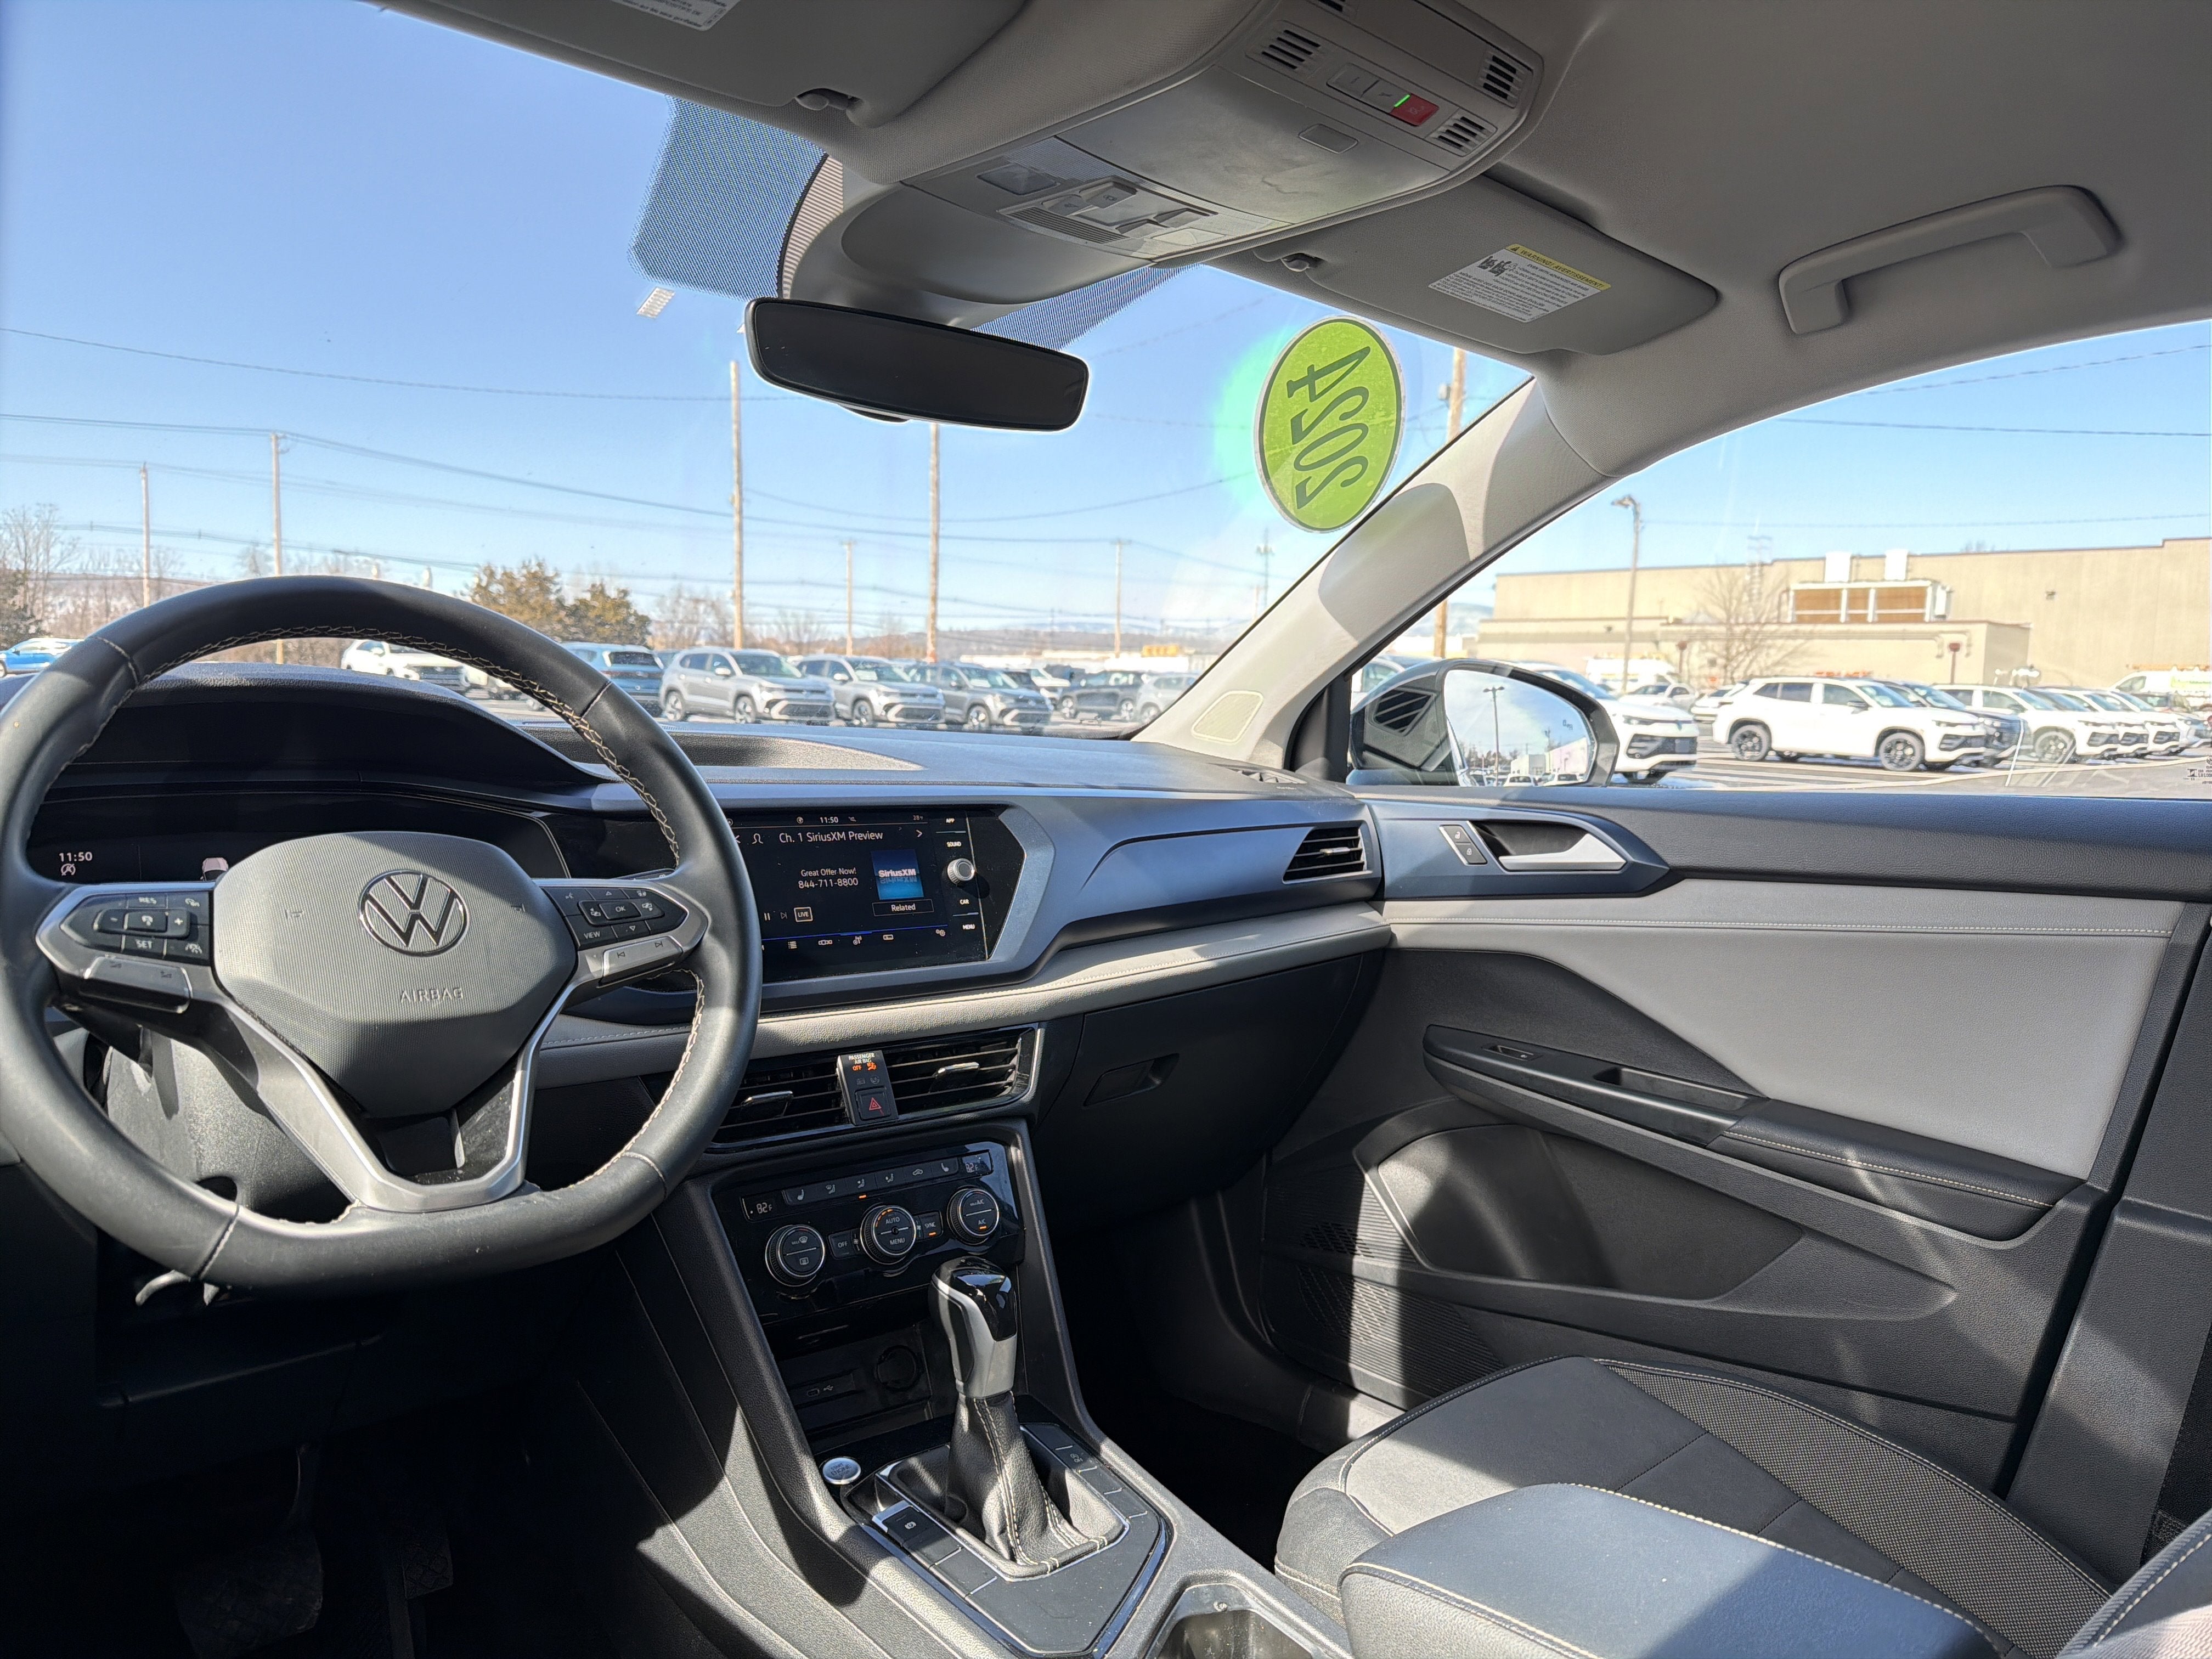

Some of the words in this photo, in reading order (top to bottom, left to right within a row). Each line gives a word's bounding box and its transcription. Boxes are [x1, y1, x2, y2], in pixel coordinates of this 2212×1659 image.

[1520, 250, 1555, 267] WARNING!
[1553, 264, 1606, 288] AVERTISSEMENT!
[779, 833, 795, 843] Ch.
[798, 832, 803, 842] 1
[806, 832, 845, 843] SiriusXM
[848, 831, 883, 841] Preview
[59, 851, 93, 862] 11:50
[839, 867, 857, 876] Now!
[878, 868, 917, 878] SiriusXM
[798, 878, 859, 889] 844-711-8800
[891, 904, 916, 912] Related
[584, 931, 601, 939] VIEW
[136, 939, 154, 949] SET
[400, 988, 464, 1003] AIRBAG
[848, 1052, 875, 1061] PASSENGER
[885, 1217, 900, 1225] AUTO
[889, 1237, 905, 1246] MENU
